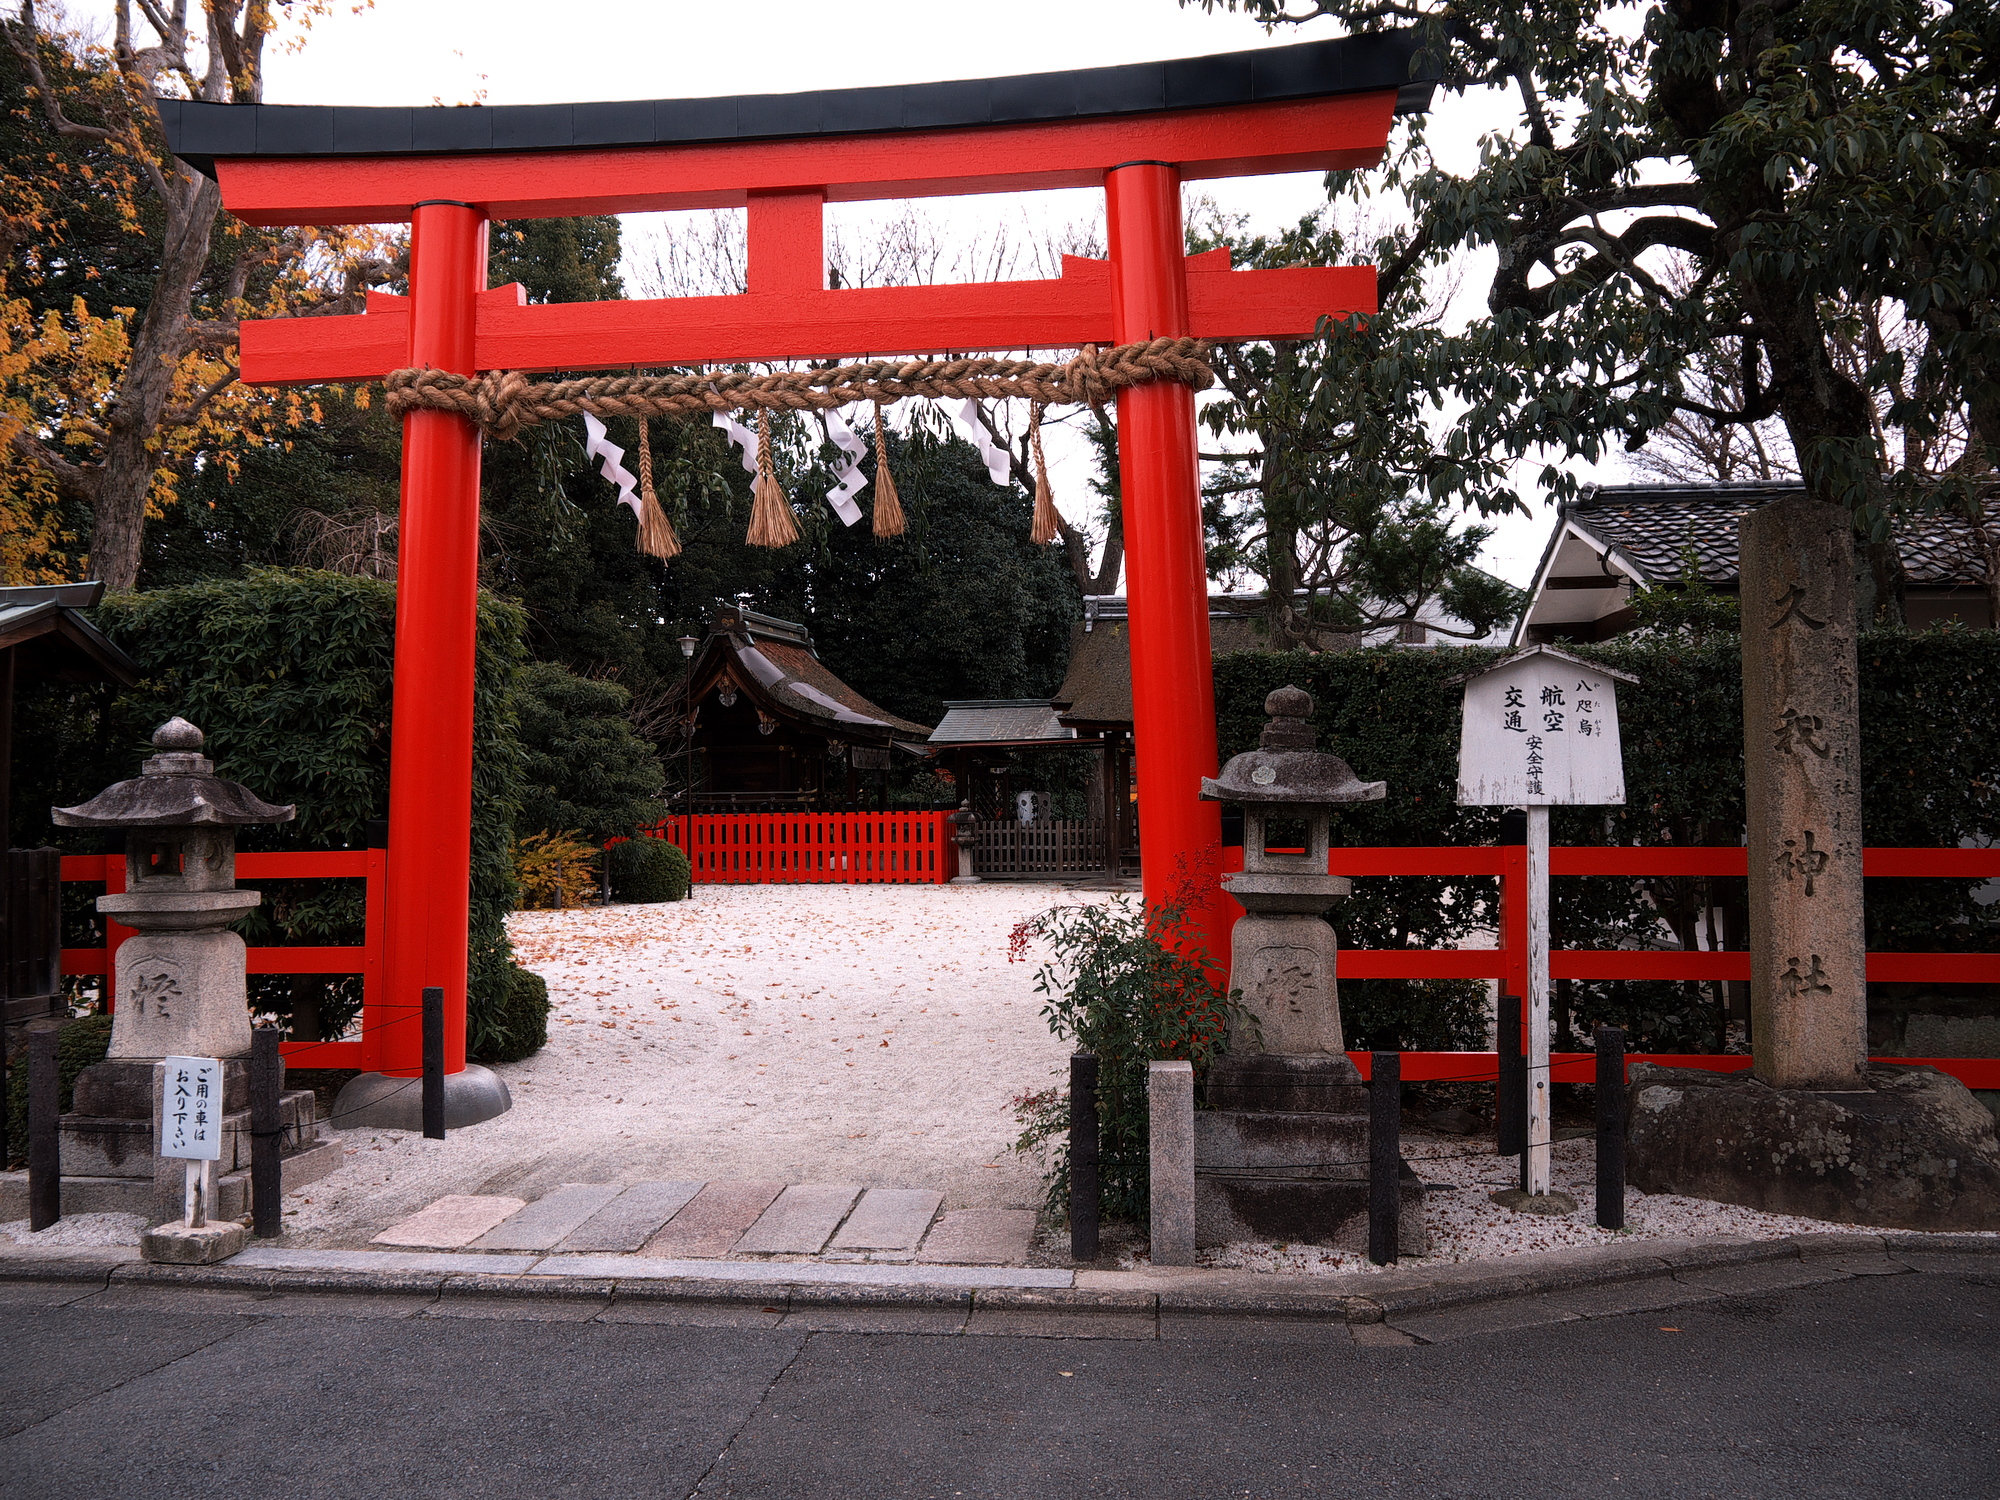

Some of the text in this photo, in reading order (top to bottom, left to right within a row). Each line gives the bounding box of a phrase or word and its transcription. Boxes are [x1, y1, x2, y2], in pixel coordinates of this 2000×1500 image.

[1503, 685, 1528, 733] 交通
[1539, 684, 1566, 733] 航空
[1525, 734, 1545, 796] 安全守護
[1766, 581, 1833, 998] 久我神社
[172, 1068, 191, 1149] お入り下さい
[193, 1067, 212, 1141] ご用の車は
